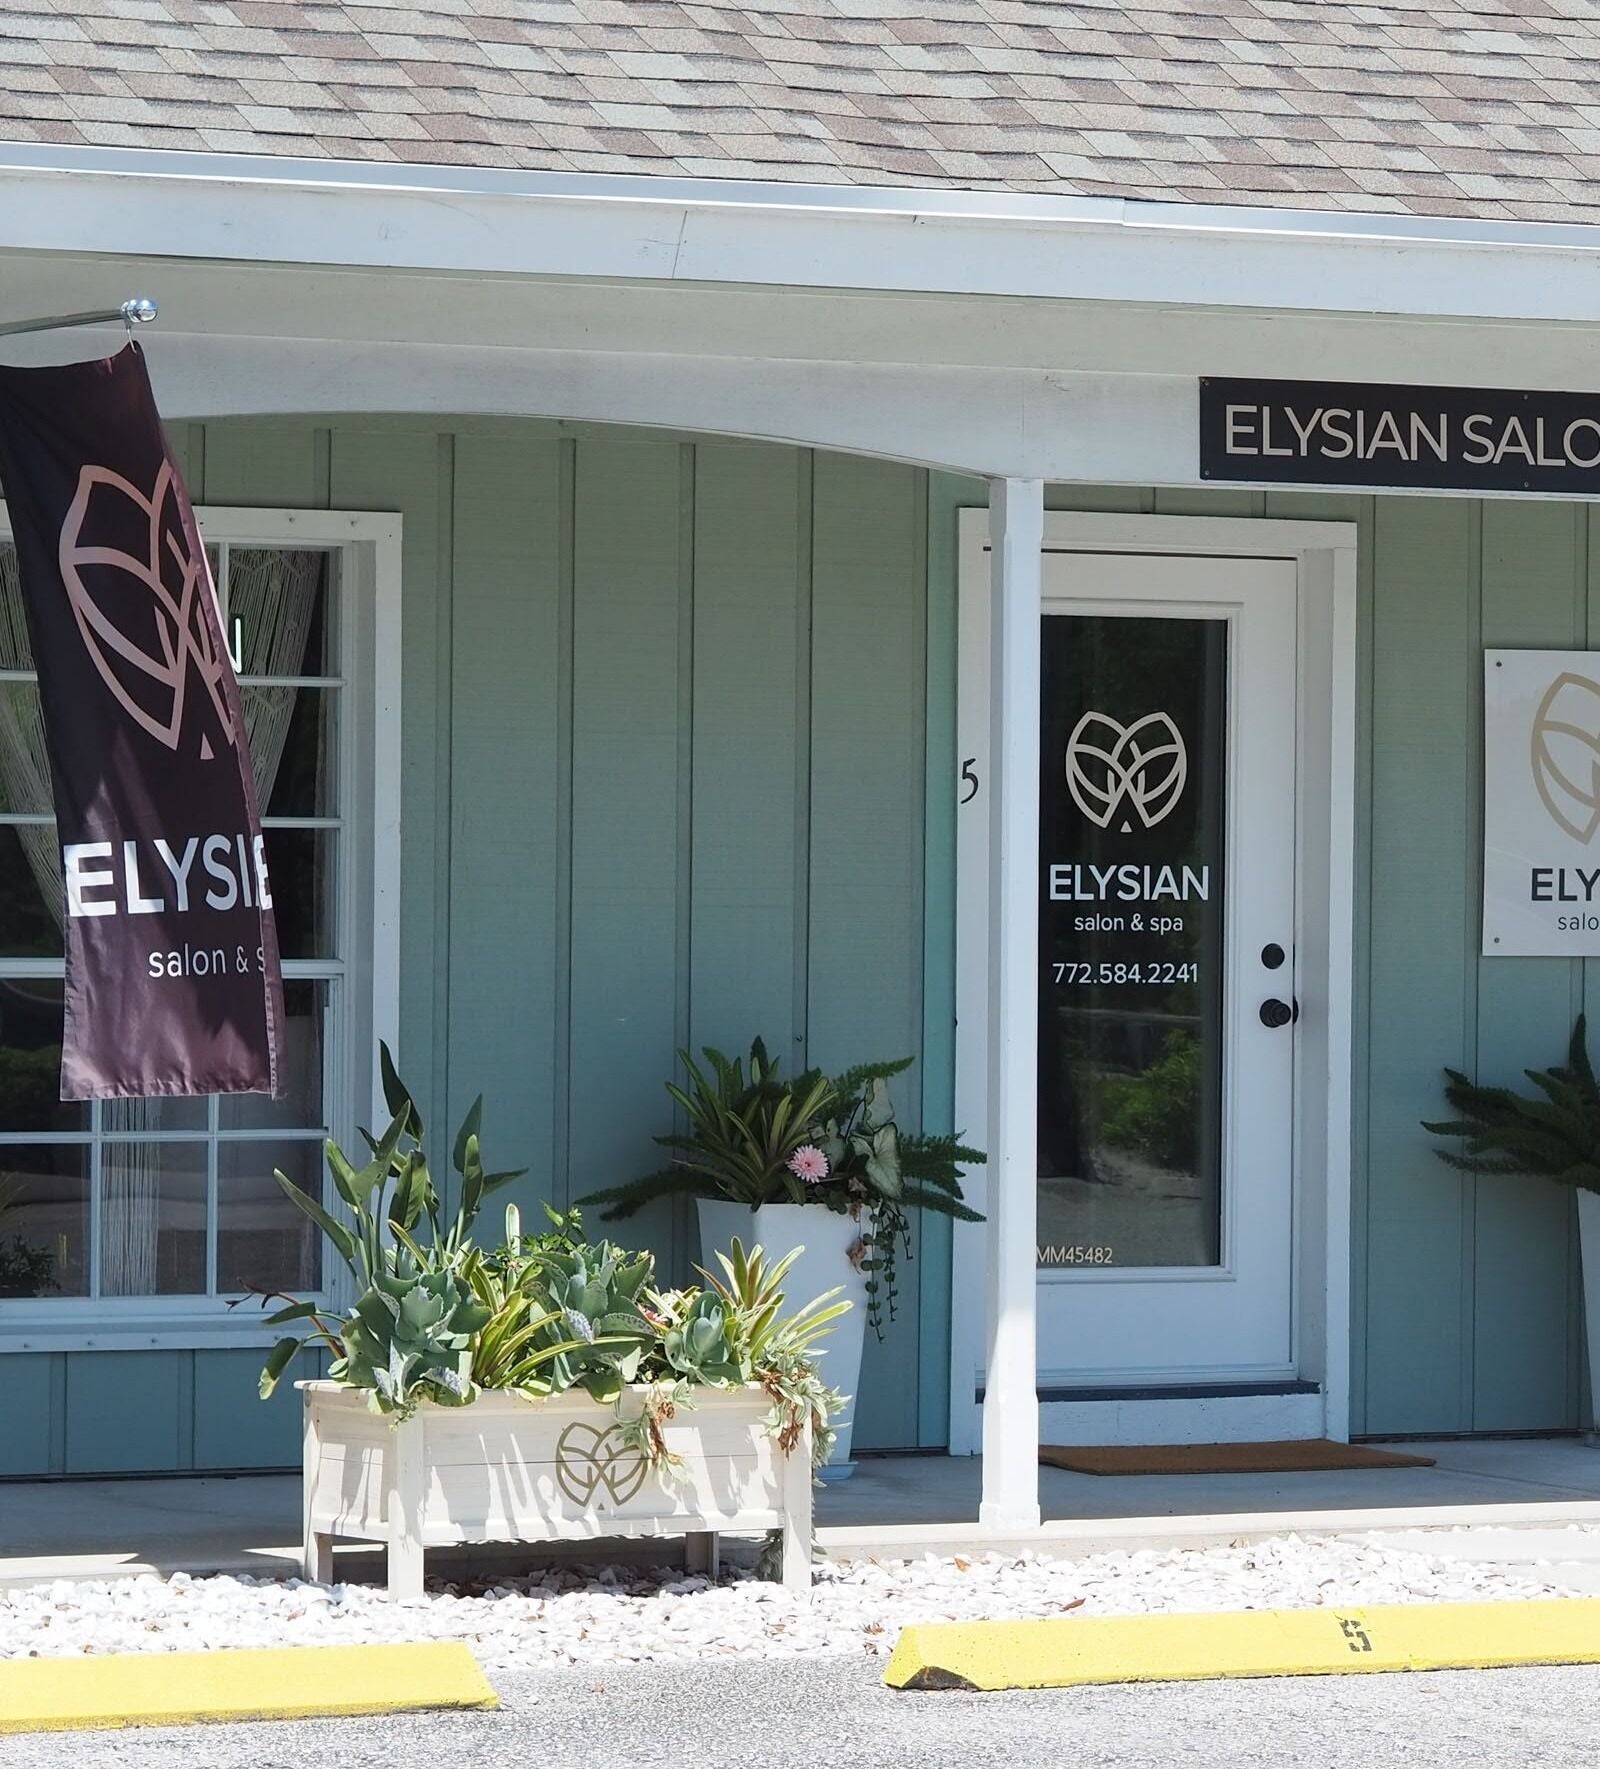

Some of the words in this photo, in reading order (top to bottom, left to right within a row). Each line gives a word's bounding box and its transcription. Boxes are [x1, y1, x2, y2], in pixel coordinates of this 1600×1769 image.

[1224, 404, 1448, 463] ELYSIAN
[961, 758, 979, 804] 5
[1050, 864, 1209, 901] ELYSIAN
[1074, 912, 1124, 932] salon
[1130, 912, 1144, 932] &
[1149, 916, 1184, 935] spa
[148, 943, 227, 978] salon
[235, 945, 249, 974] &
[1052, 963, 1198, 984] 772.584.2241
[1339, 1619, 1372, 1652] 5
